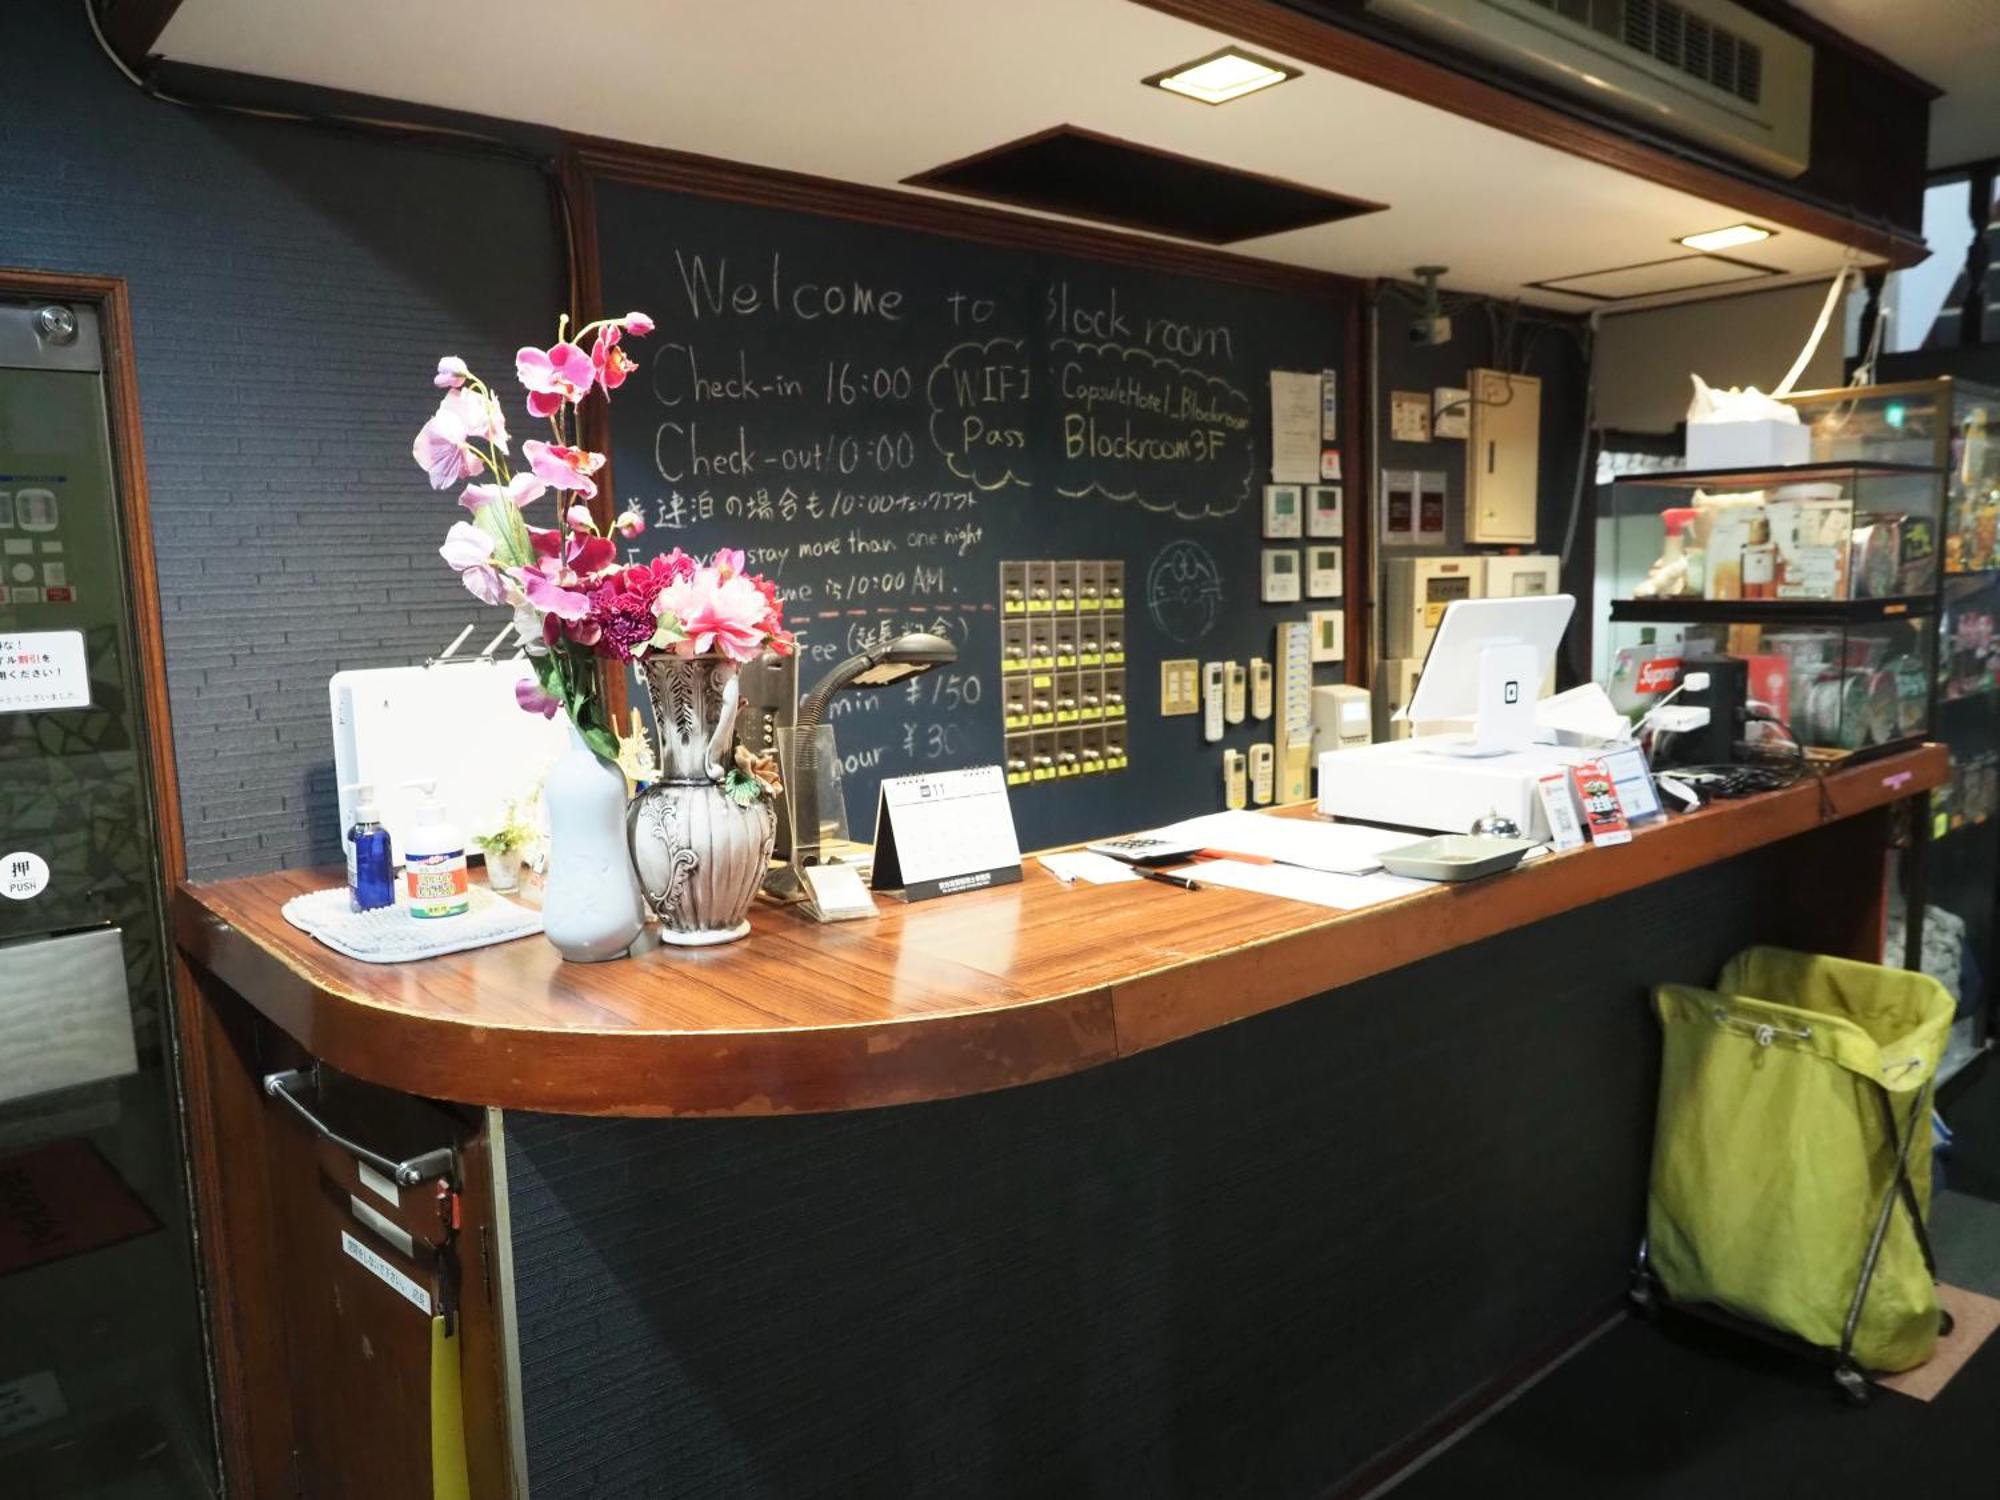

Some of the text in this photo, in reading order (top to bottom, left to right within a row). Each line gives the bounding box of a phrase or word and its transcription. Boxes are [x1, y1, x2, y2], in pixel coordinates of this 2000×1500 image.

[675, 250, 903, 320] Welcome
[948, 291, 995, 325] to
[1145, 319, 1233, 360] room
[653, 343, 911, 406] Check-in 16:00
[954, 364, 1031, 408] WIFI
[655, 422, 914, 482] Check-out 10:00
[963, 415, 1025, 453] Pass
[1064, 413, 1226, 462] Blockroom3F
[747, 547, 791, 577] stay
[799, 536, 842, 559] more
[848, 528, 897, 555] than
[906, 530, 939, 548] one
[943, 522, 983, 557] night
[773, 583, 813, 602] ime
[846, 571, 906, 600] 10:00
[795, 630, 838, 663] Fee
[828, 690, 881, 720] min
[10, 882, 37, 893] PUSH
